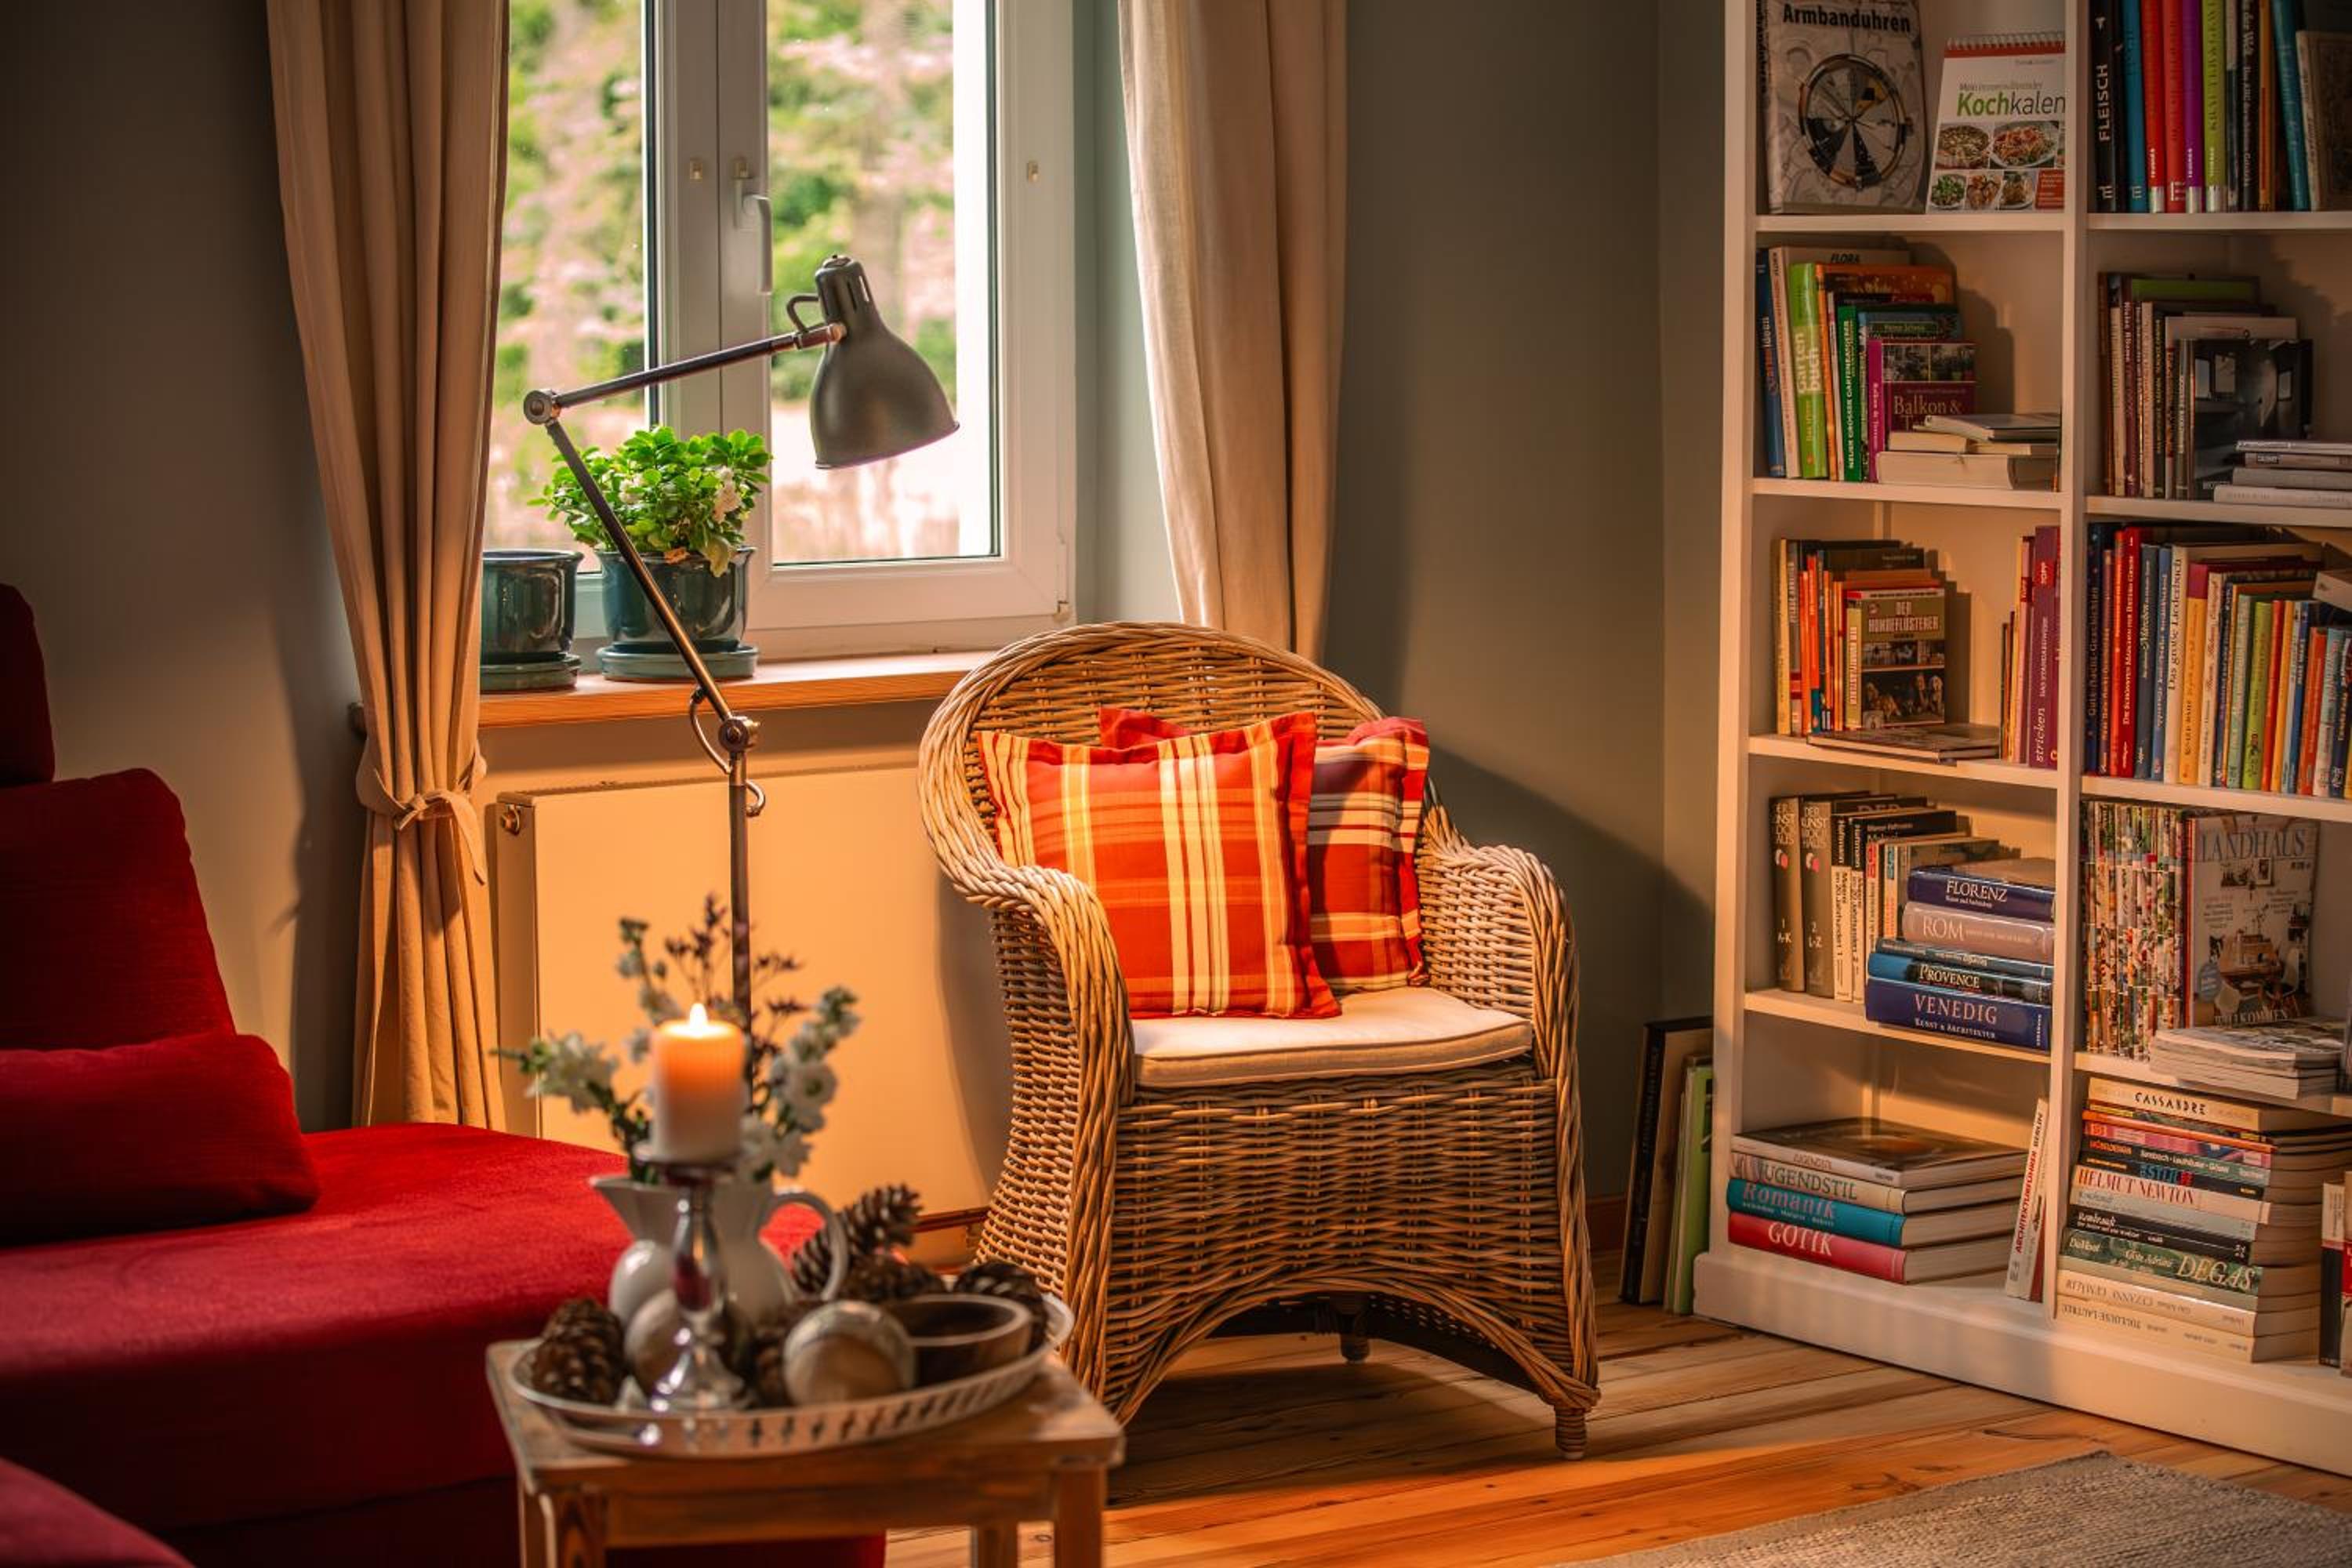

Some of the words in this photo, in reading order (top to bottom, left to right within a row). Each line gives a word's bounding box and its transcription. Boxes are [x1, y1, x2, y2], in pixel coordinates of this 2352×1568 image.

[1783, 3, 1911, 32] Armbanduhren
[2096, 64, 2111, 141] FLEISCH
[1831, 252, 1860, 264] FLORA
[1808, 347, 1821, 392] buch
[1893, 395, 1945, 415] Balkon
[1949, 397, 1962, 415] &
[1895, 601, 1912, 615] DER
[2168, 668, 2176, 691] Das
[2035, 708, 2045, 763] stricken
[1946, 880, 2007, 902] FLORENZ
[1811, 921, 1817, 933] 2
[1923, 918, 1964, 941] ROM
[1919, 964, 1980, 989] PROVENCE
[1914, 993, 1997, 1025] VENEDIG
[2135, 1091, 2209, 1116] CASSANDRE
[1757, 1161, 1857, 1200] JUGENDSTIL
[2078, 1168, 2137, 1194] HELMUT
[2139, 1180, 2195, 1205] NEWTON
[1742, 1182, 1837, 1219] Romanik
[1768, 1221, 1833, 1256] GOTIK
[2176, 1255, 2255, 1290] DEGAS
